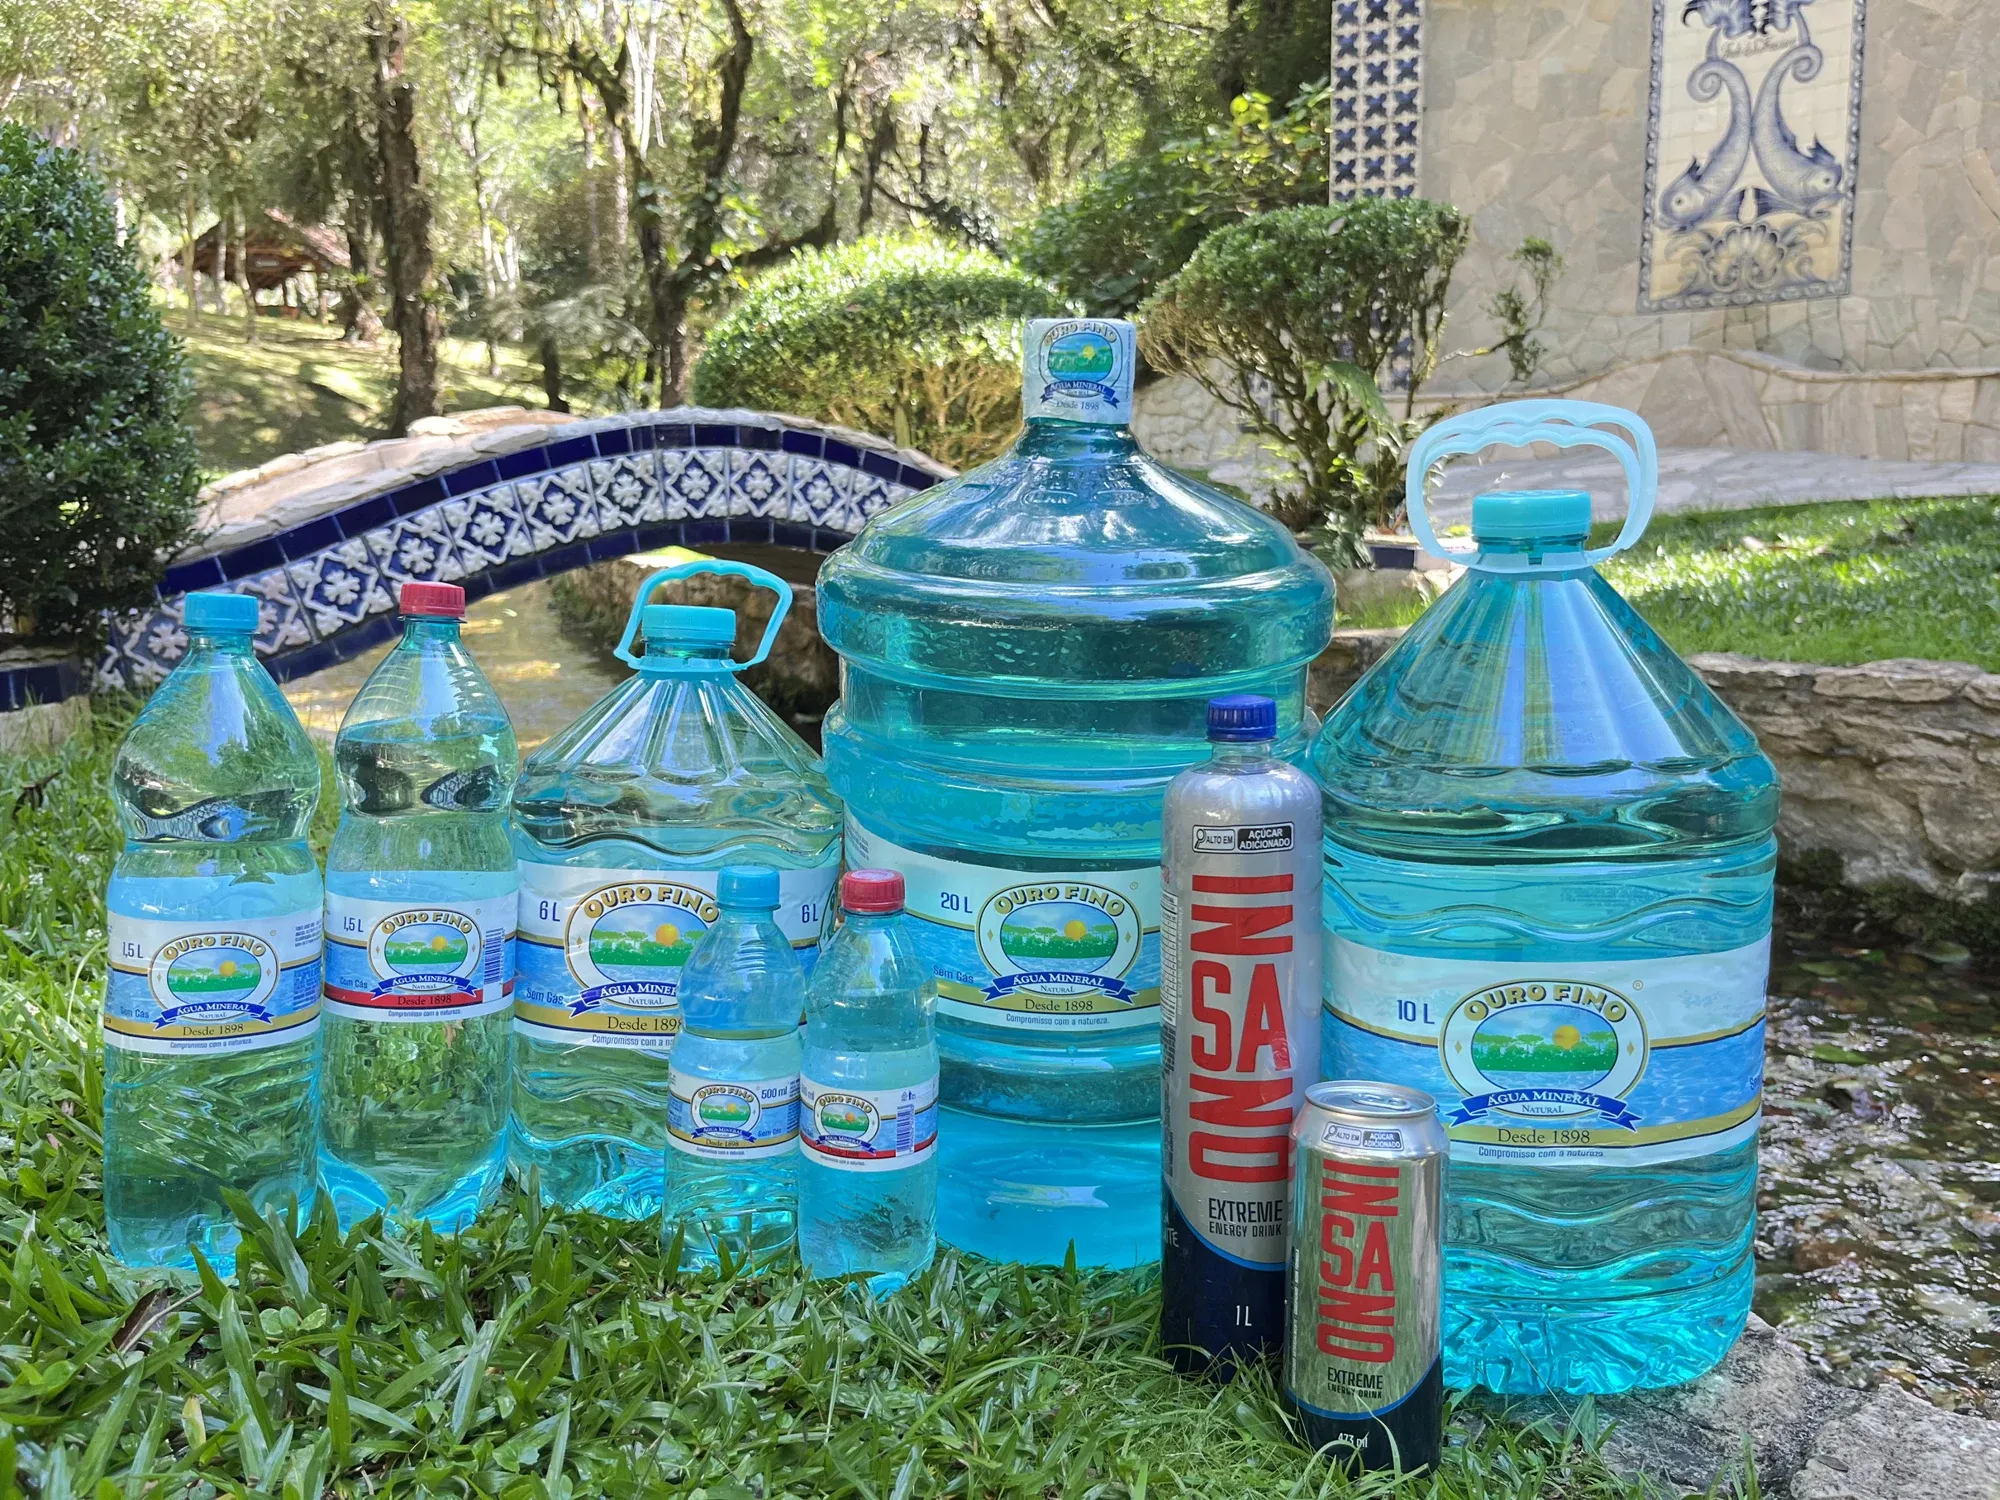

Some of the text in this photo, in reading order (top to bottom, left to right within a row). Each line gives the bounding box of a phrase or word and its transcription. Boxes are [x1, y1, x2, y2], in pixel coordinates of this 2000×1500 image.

[1056, 401, 1078, 409] Desde
[1206, 835, 1233, 844] ALTO EM
[1248, 828, 1283, 841] AÇÚCAR
[1239, 838, 1290, 850] ADICIONADO
[584, 885, 720, 923] OURO FINO
[941, 891, 973, 914] 20 L
[994, 886, 1125, 917] OURO FINO
[381, 912, 473, 935] OURO FINO
[163, 935, 267, 960] OURO FINO
[392, 975, 458, 985] ÁGUA MINERAL
[933, 964, 974, 984] Sem Gás
[1012, 973, 1105, 987] ÁGUA MINERAL
[526, 987, 564, 1005] Sem Gás
[600, 984, 635, 998] ÁGUA
[397, 995, 452, 1005] Desde 1898
[1025, 999, 1093, 1011] Desde 1898
[1464, 984, 1627, 1023] OURO FINO
[177, 1003, 251, 1015] ÁGUA MINERAL
[1397, 1000, 1435, 1024] 10 L
[608, 1016, 648, 1030] Desde
[1006, 1013, 1052, 1025] Compromisso
[1054, 1017, 1069, 1025] com
[183, 1023, 244, 1036] Desde 1898
[592, 1034, 639, 1045] Compromisso
[698, 1087, 754, 1103] OURO FINO
[761, 1089, 777, 1099] 500
[778, 1086, 788, 1097] ml
[1487, 1091, 1601, 1107] ÁGUA MINERAL
[819, 1095, 872, 1113] OURO FINO
[1336, 1131, 1359, 1141] ALTO EM
[1497, 1129, 1591, 1144] Desde 1898
[1364, 1139, 1400, 1148] ADICIONADO
[1478, 1146, 1536, 1159] Compromisso
[1538, 1149, 1556, 1157] com
[1208, 1197, 1283, 1223] EXTREME
[1209, 1221, 1282, 1238] ENERGY DRINK
[1327, 1366, 1383, 1389] EXTREME
[1327, 1383, 1382, 1399] ENERGY DRINK
